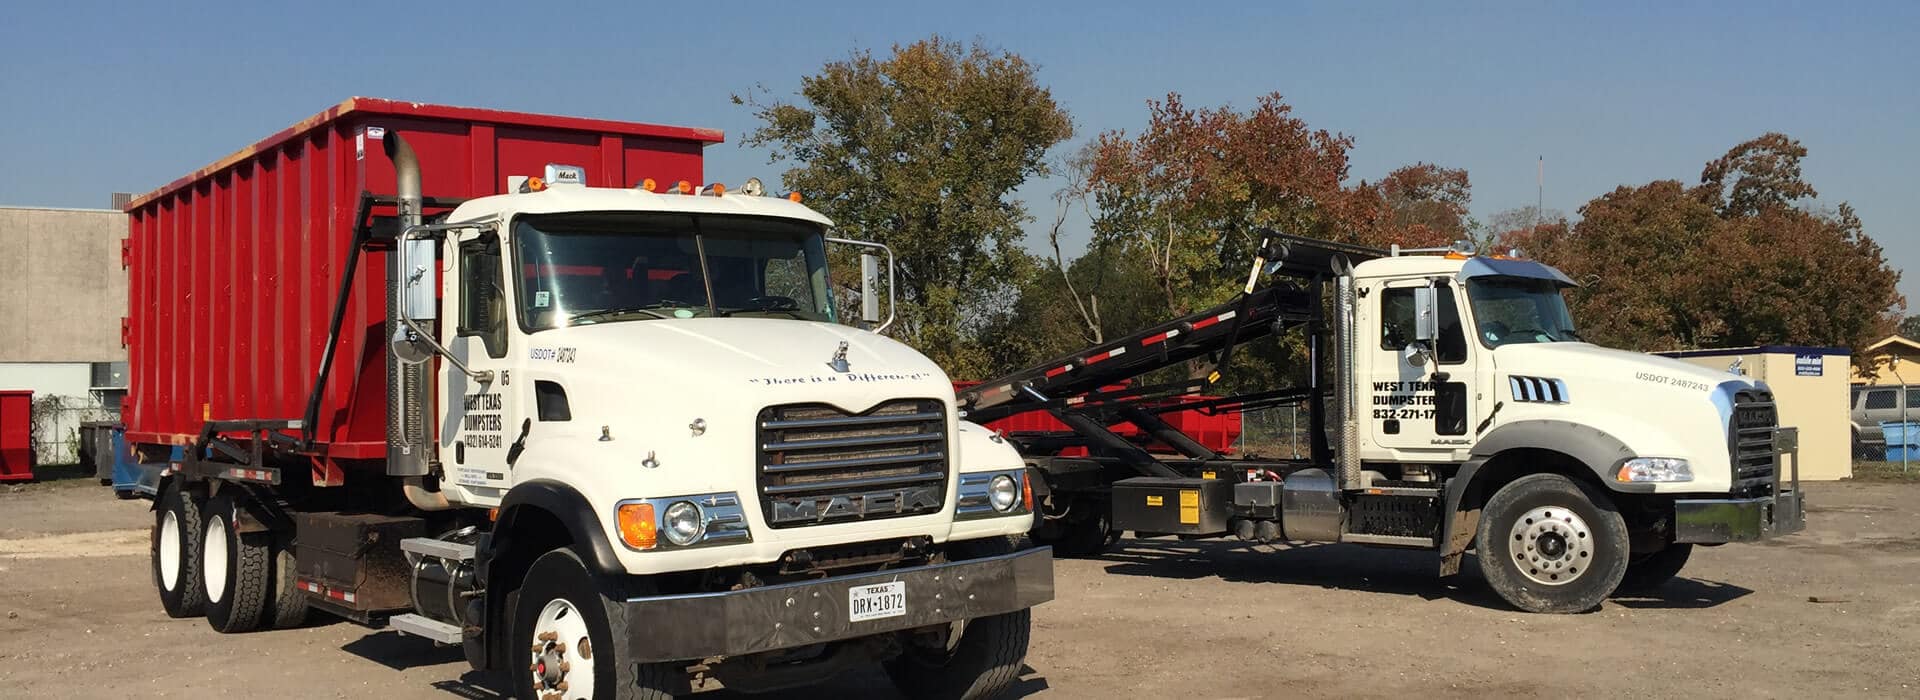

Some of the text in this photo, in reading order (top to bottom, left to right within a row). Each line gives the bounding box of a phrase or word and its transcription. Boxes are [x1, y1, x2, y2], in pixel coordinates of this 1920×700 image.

[558, 171, 577, 179] Mack
[530, 348, 556, 360] USDOT#
[501, 370, 510, 386] 05
[1635, 371, 1710, 392] USDOT 2487243
[1373, 381, 1437, 392] WEST TEXA
[464, 393, 502, 411] WEST TEXAS
[1373, 395, 1437, 406] DUMPSTER
[1373, 409, 1437, 419] 832-271-17
[464, 414, 502, 431] DUMPSTERS
[464, 434, 502, 449] (432) 614-5241
[770, 487, 941, 525] MACK
[867, 585, 889, 594] TEXAS
